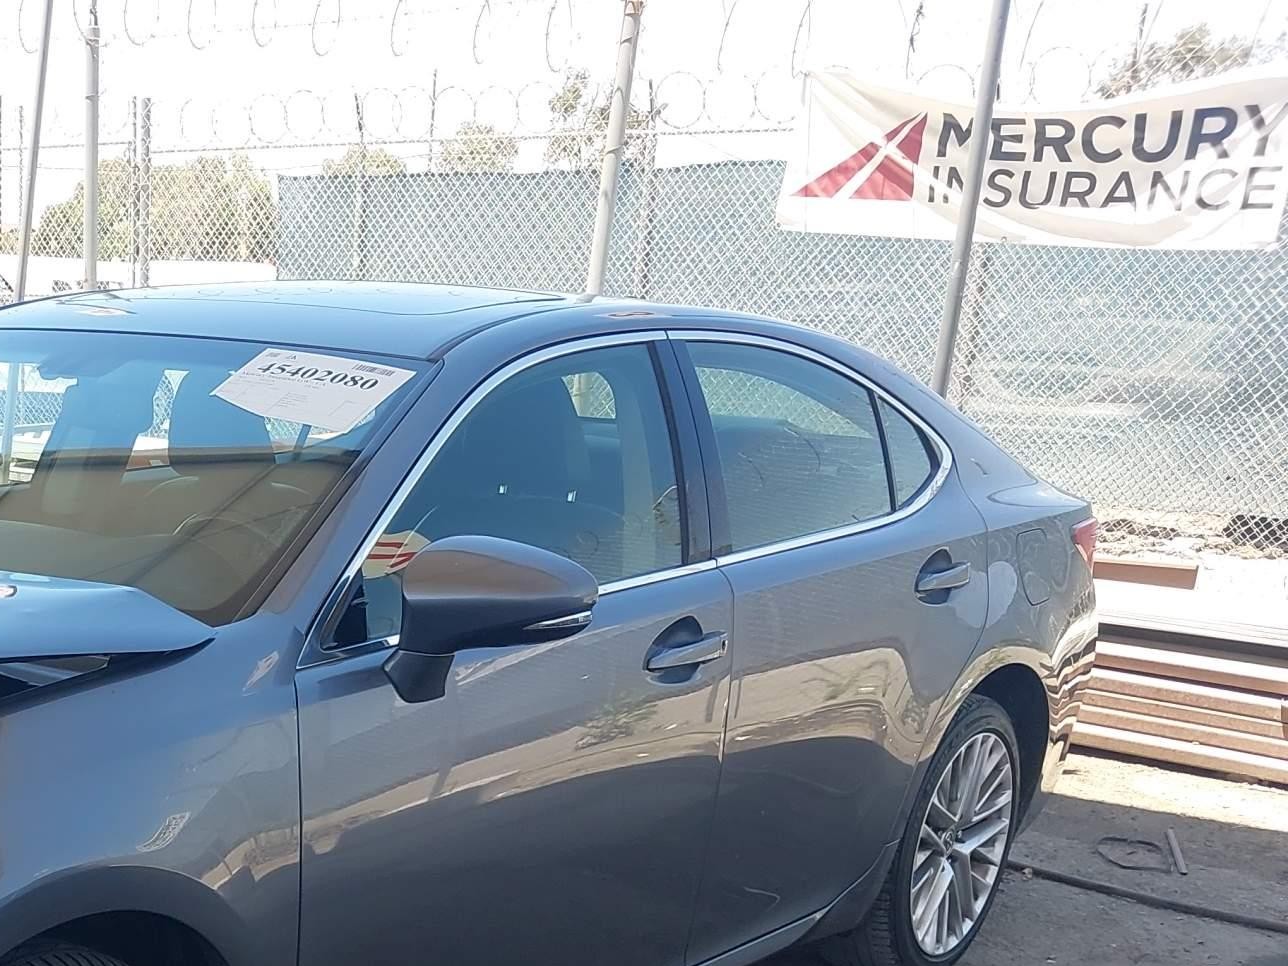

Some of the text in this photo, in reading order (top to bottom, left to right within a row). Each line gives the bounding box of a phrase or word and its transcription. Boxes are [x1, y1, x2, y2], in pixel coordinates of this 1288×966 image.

[936, 102, 1288, 164] MERCURY
[927, 164, 1283, 211] INSURANCE
[257, 361, 380, 390] 45402080
